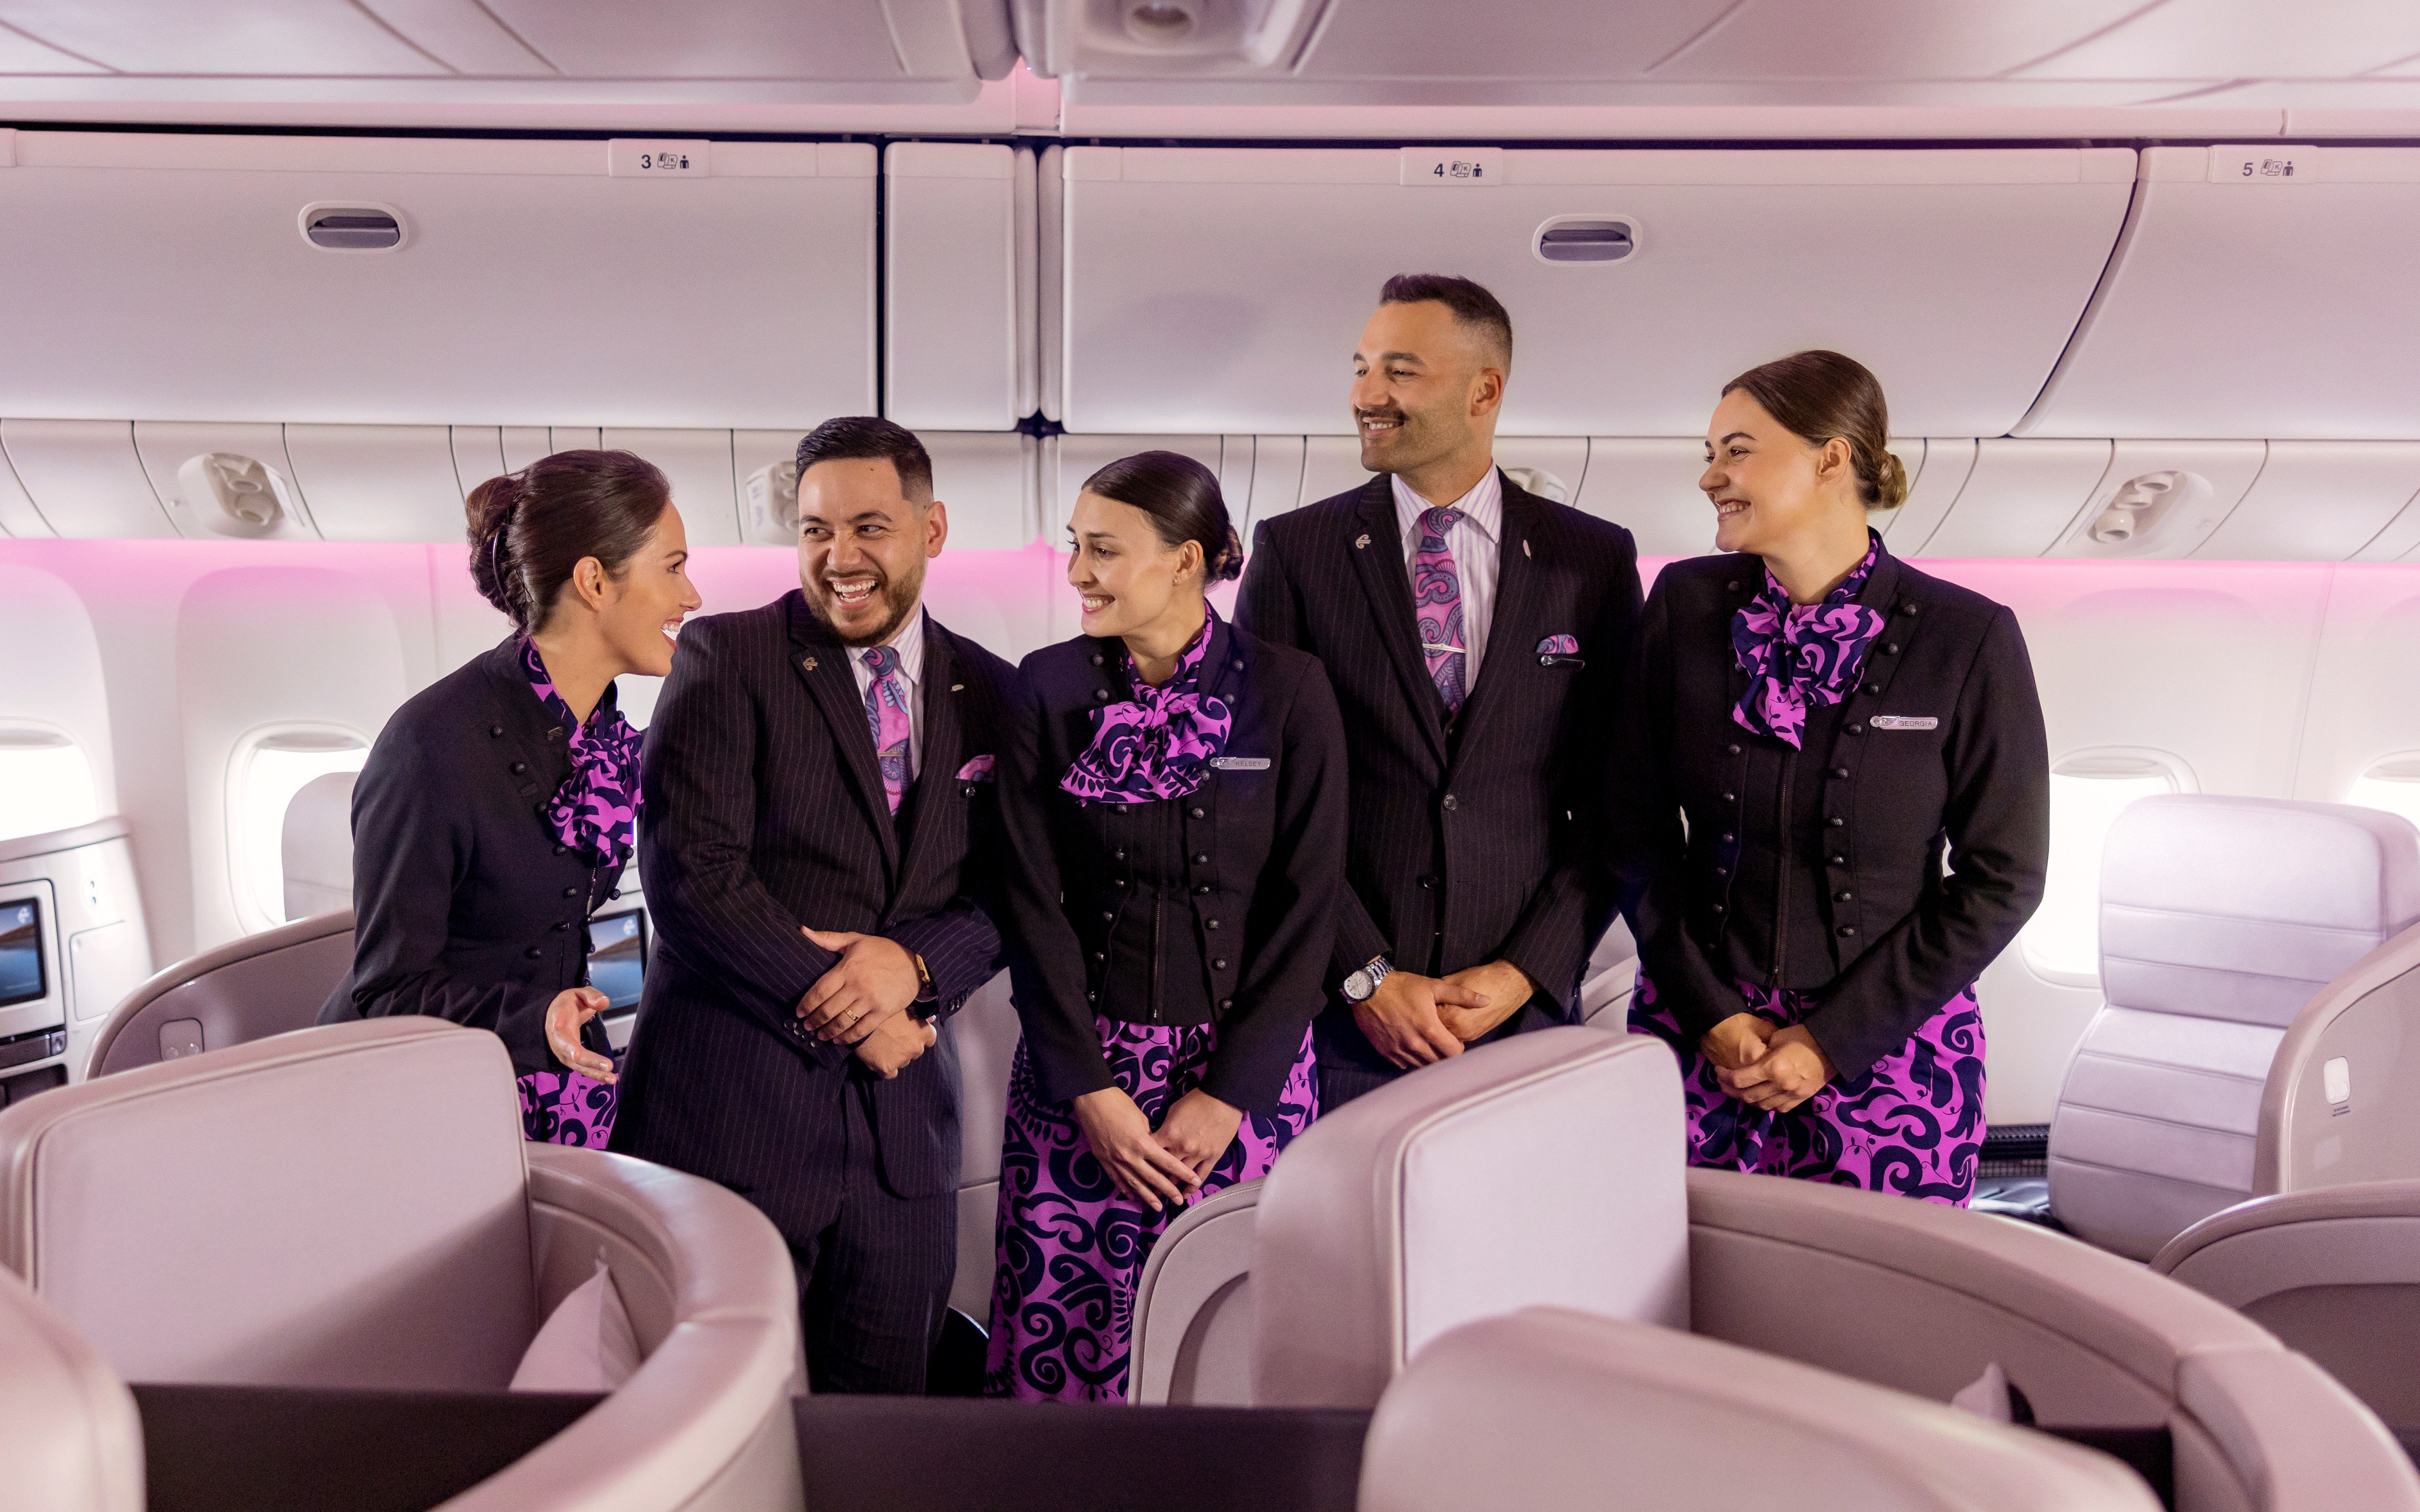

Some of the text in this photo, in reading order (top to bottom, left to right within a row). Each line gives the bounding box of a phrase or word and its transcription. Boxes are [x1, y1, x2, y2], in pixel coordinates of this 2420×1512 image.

[642, 155, 651, 169] 3
[1434, 163, 1444, 177] 4
[2243, 163, 2253, 176] 5
